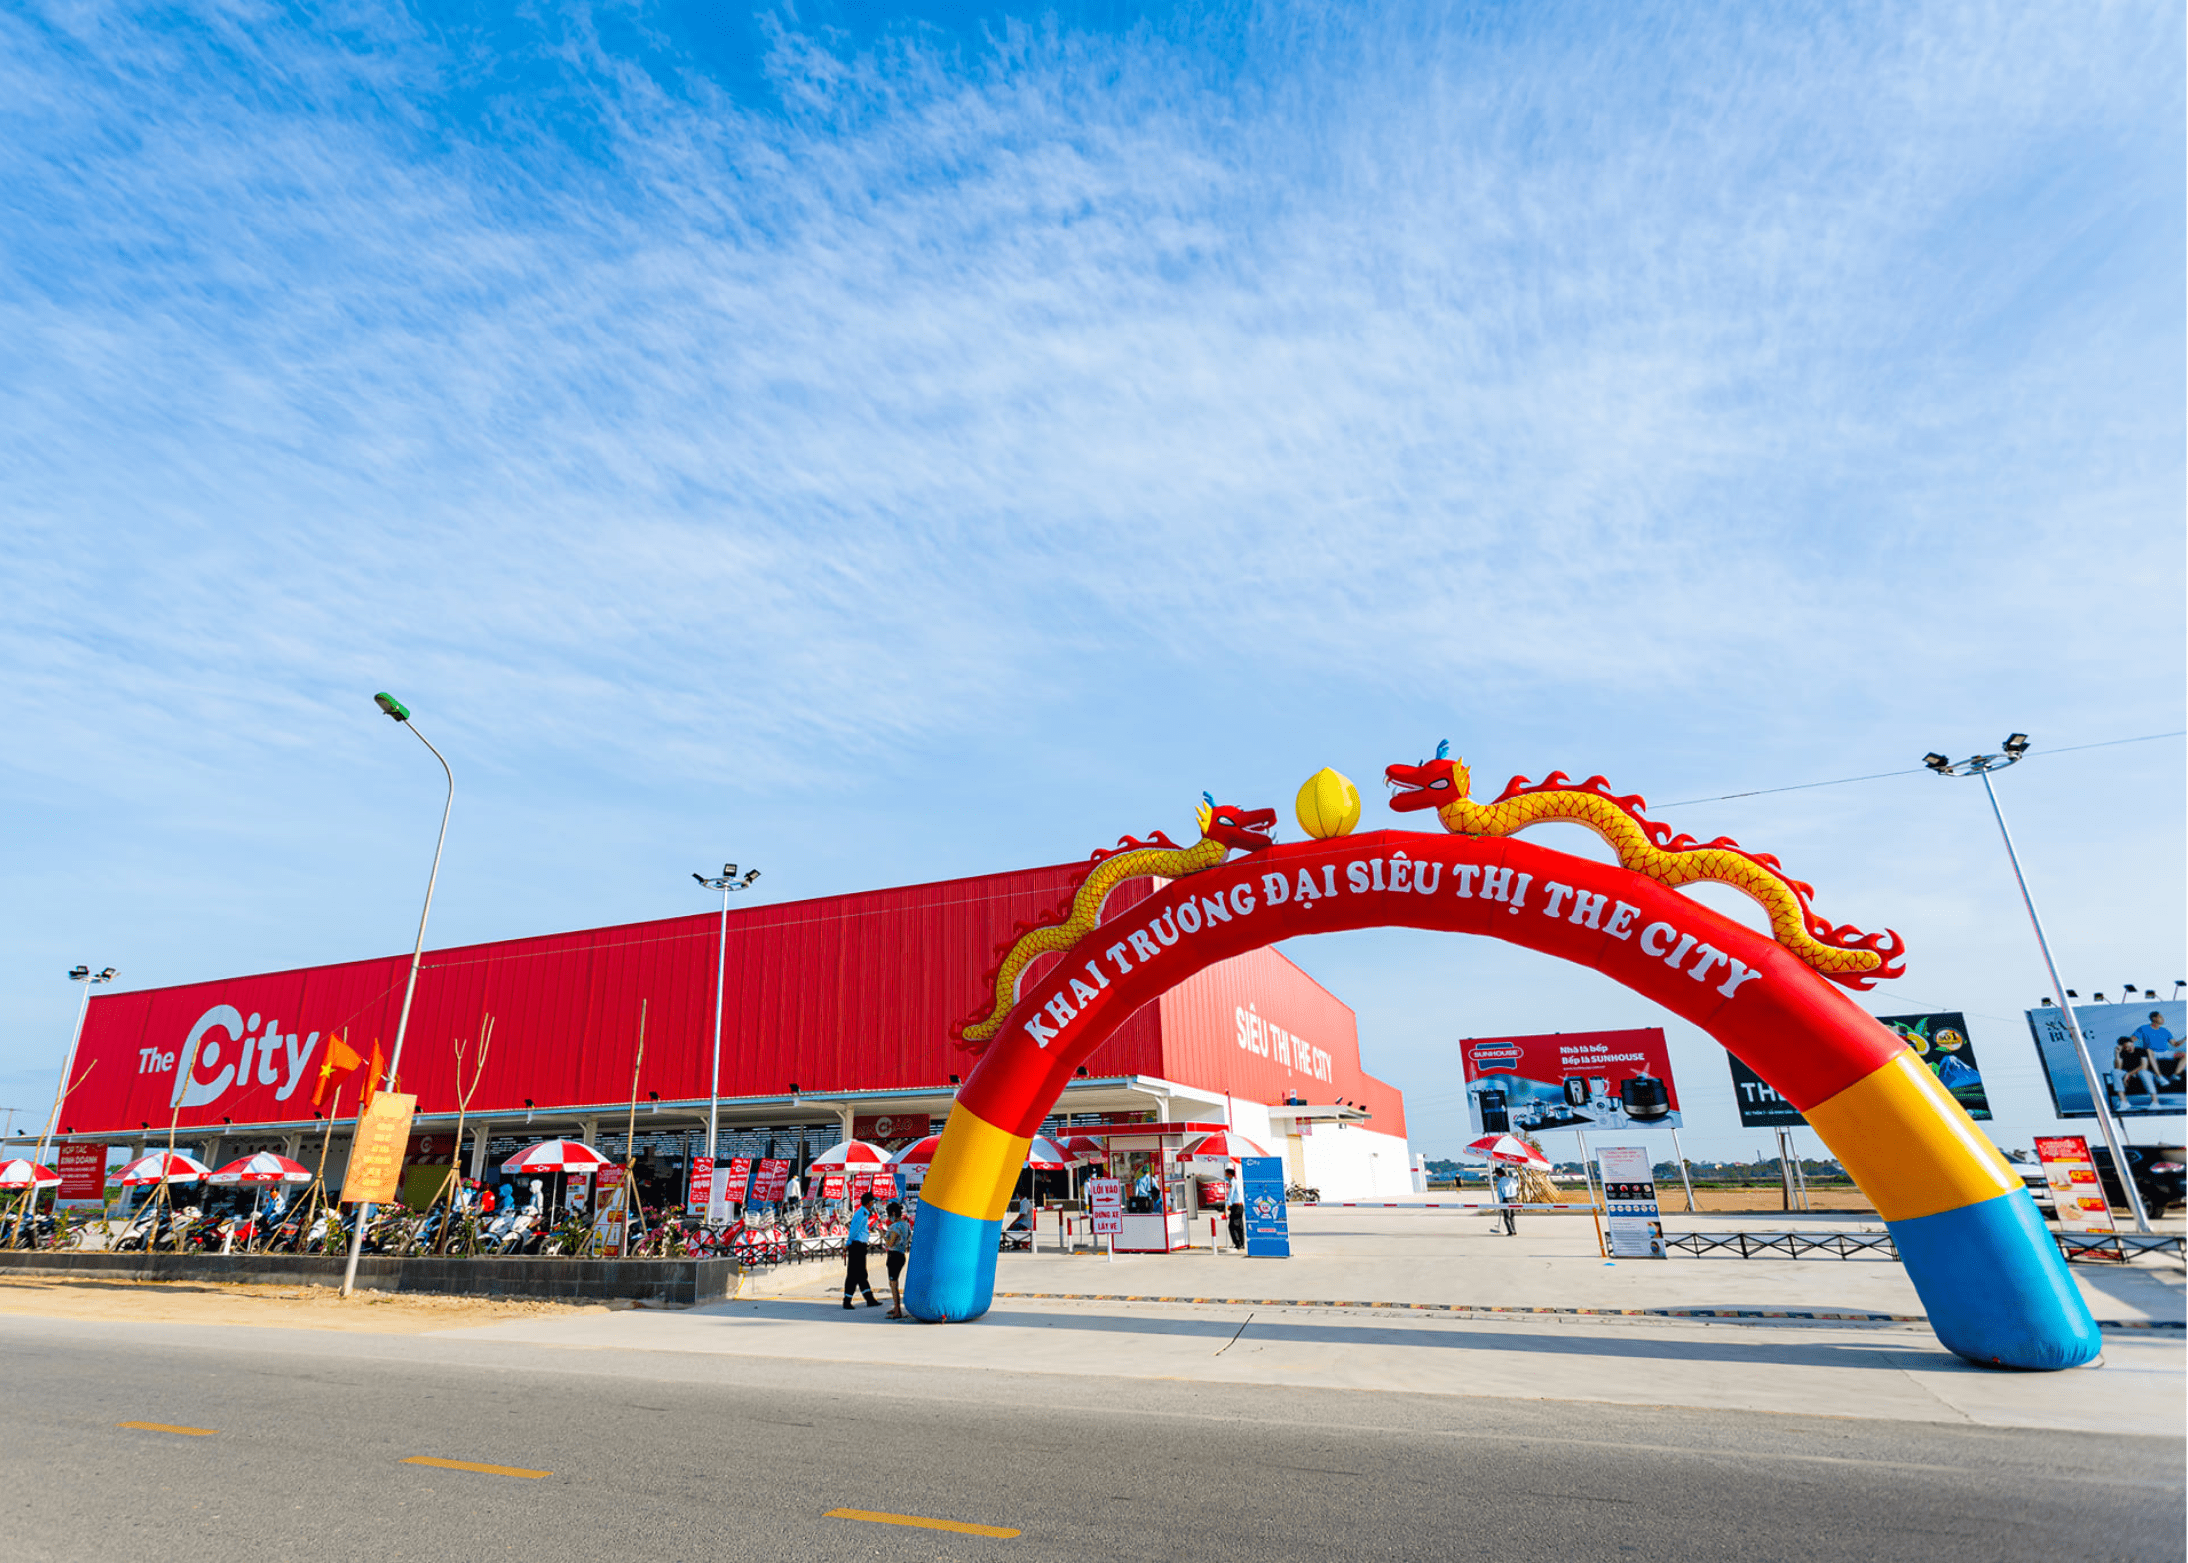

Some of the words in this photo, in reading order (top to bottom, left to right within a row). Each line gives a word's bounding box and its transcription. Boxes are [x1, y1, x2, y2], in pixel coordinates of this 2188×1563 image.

[1024, 960, 1111, 1048] KHAI
[1106, 883, 1256, 974] TRƯƠNG
[1262, 865, 1339, 909] ĐẠI
[1346, 849, 1443, 895] SIÊU
[1452, 863, 1534, 915] THỊ
[1543, 881, 1642, 941] THE
[1639, 922, 1763, 999] CITY
[138, 1046, 175, 1074] The
[169, 1004, 320, 1108] City
[1235, 1002, 1269, 1058] SIÊU
[1269, 1022, 1292, 1077] THỊ
[1290, 1034, 1313, 1076] THE
[1312, 1046, 1333, 1084] CITY
[1473, 1049, 1518, 1058] SUNHOUSE
[1559, 1046, 1579, 1054] Nhà
[1579, 1045, 1589, 1053] là
[1589, 1043, 1608, 1054] bếp
[1561, 1055, 1580, 1065] Bếp
[1580, 1055, 1590, 1064] là
[1590, 1052, 1645, 1063] SUNHOUSE
